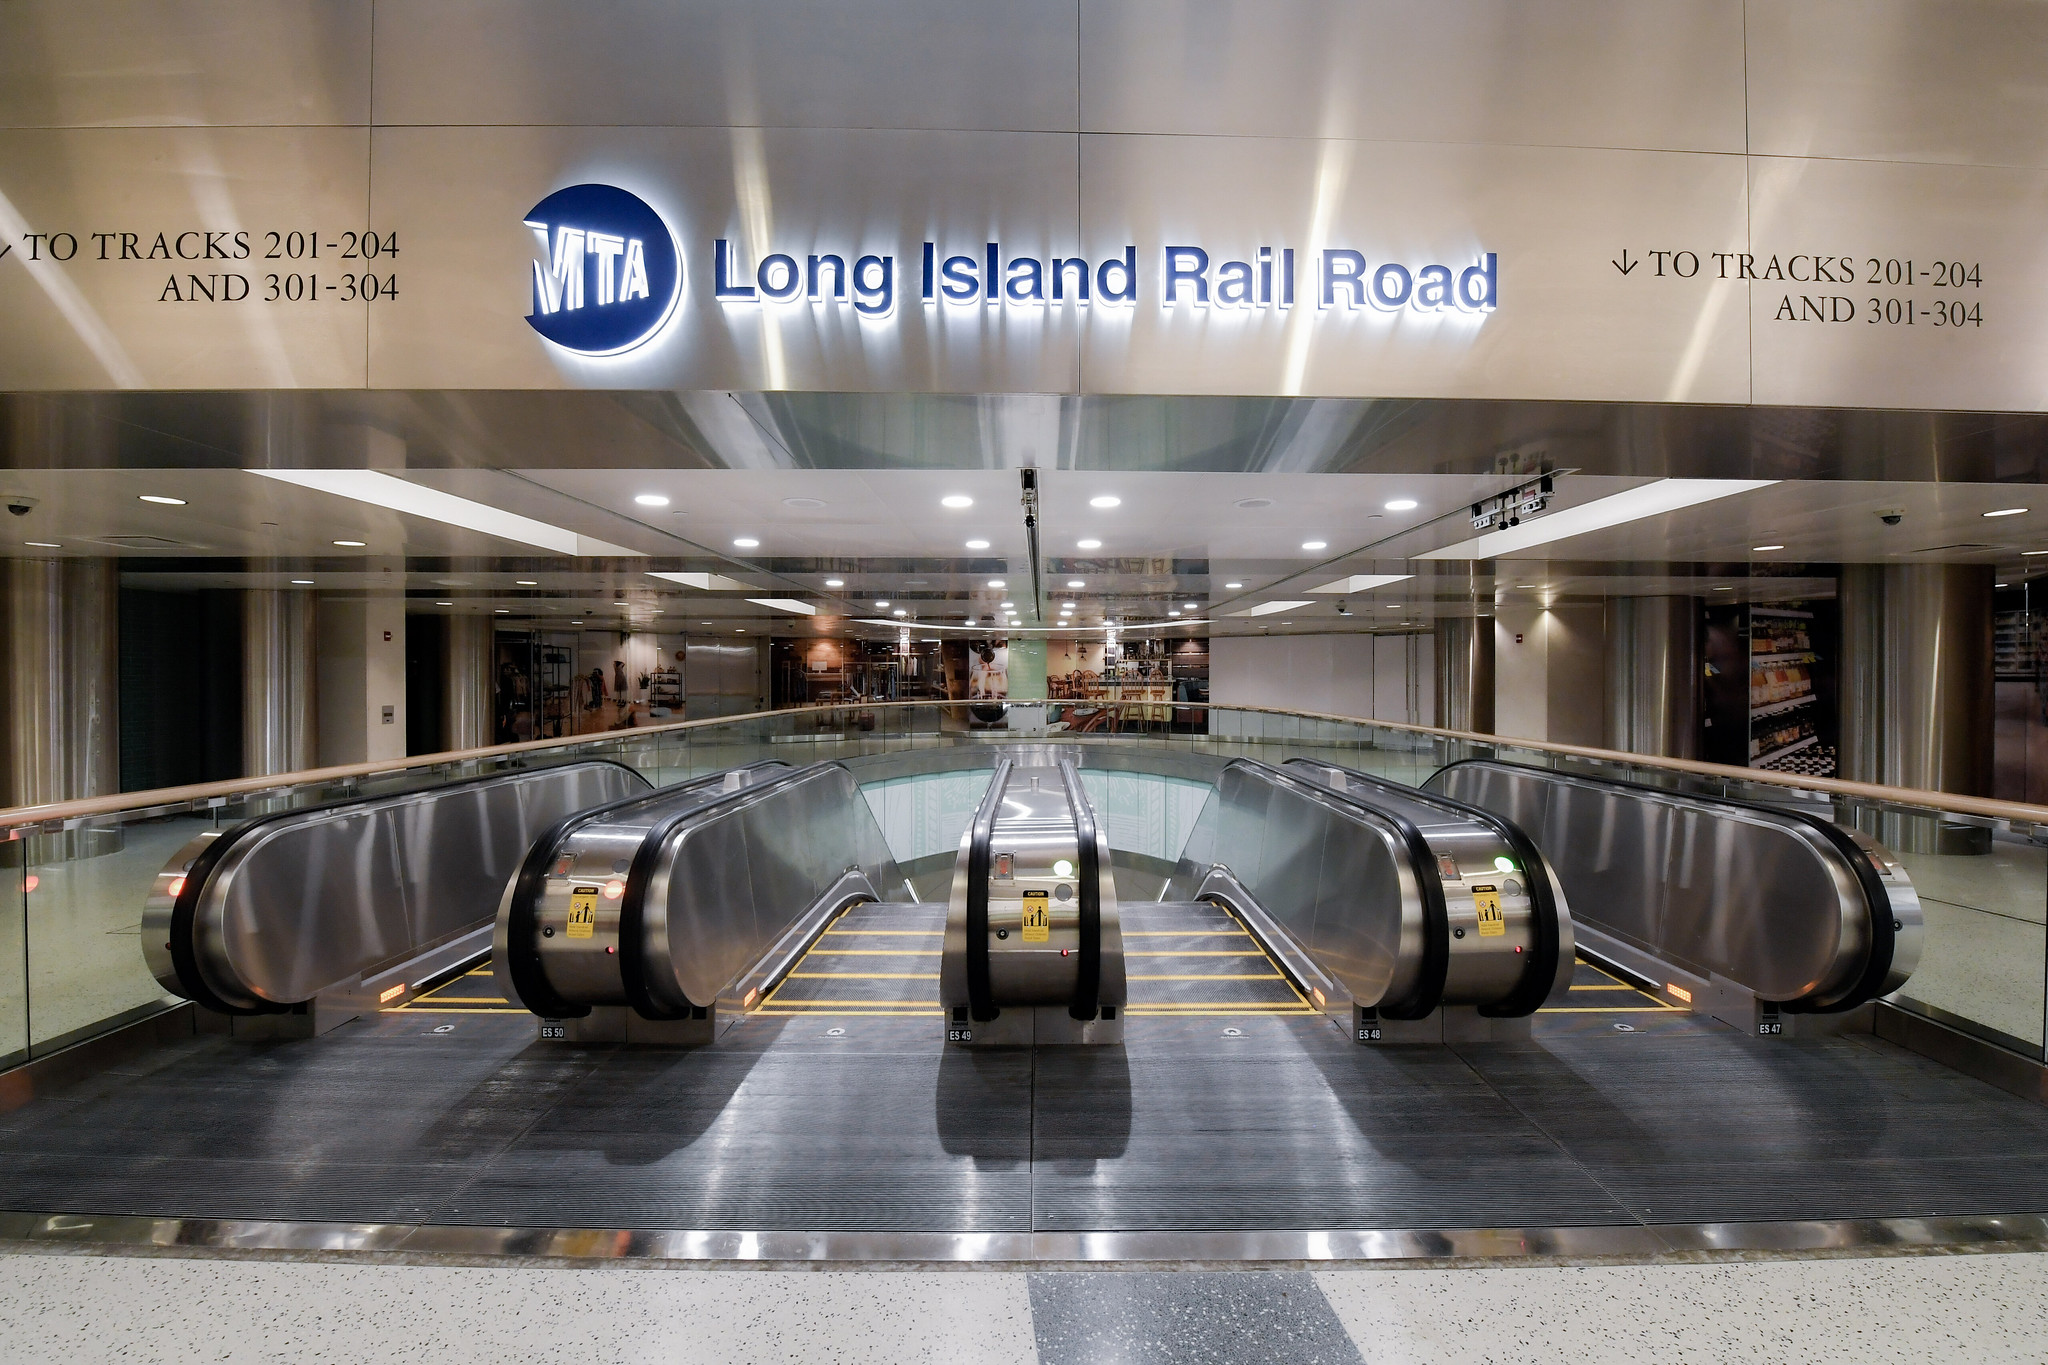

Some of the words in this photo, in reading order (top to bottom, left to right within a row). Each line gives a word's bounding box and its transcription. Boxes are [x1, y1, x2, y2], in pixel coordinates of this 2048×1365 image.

[23, 232, 78, 261] TO
[91, 231, 251, 261] TRACKS
[264, 231, 400, 260] 201-204
[523, 221, 650, 315] MTA
[714, 239, 895, 317] Long
[922, 241, 1137, 304] Island
[1164, 246, 1294, 308] Rail
[1321, 248, 1498, 310] Road
[1648, 250, 1700, 279] TO
[1711, 252, 1855, 284] TRACKS
[1866, 258, 1983, 289] 201-204
[158, 273, 250, 302] AND
[264, 273, 400, 302] 301-304
[1774, 295, 1855, 323] AND
[1867, 298, 1983, 328] 301-304
[542, 1027, 553, 1037] ES
[554, 1027, 564, 1038] 50
[949, 1030, 960, 1041] ES
[961, 1030, 971, 1041] 49
[1359, 1029, 1370, 1040] ES
[1370, 1029, 1381, 1039] 48
[1759, 1024, 1770, 1034] ES
[1771, 1024, 1781, 1034] 47
